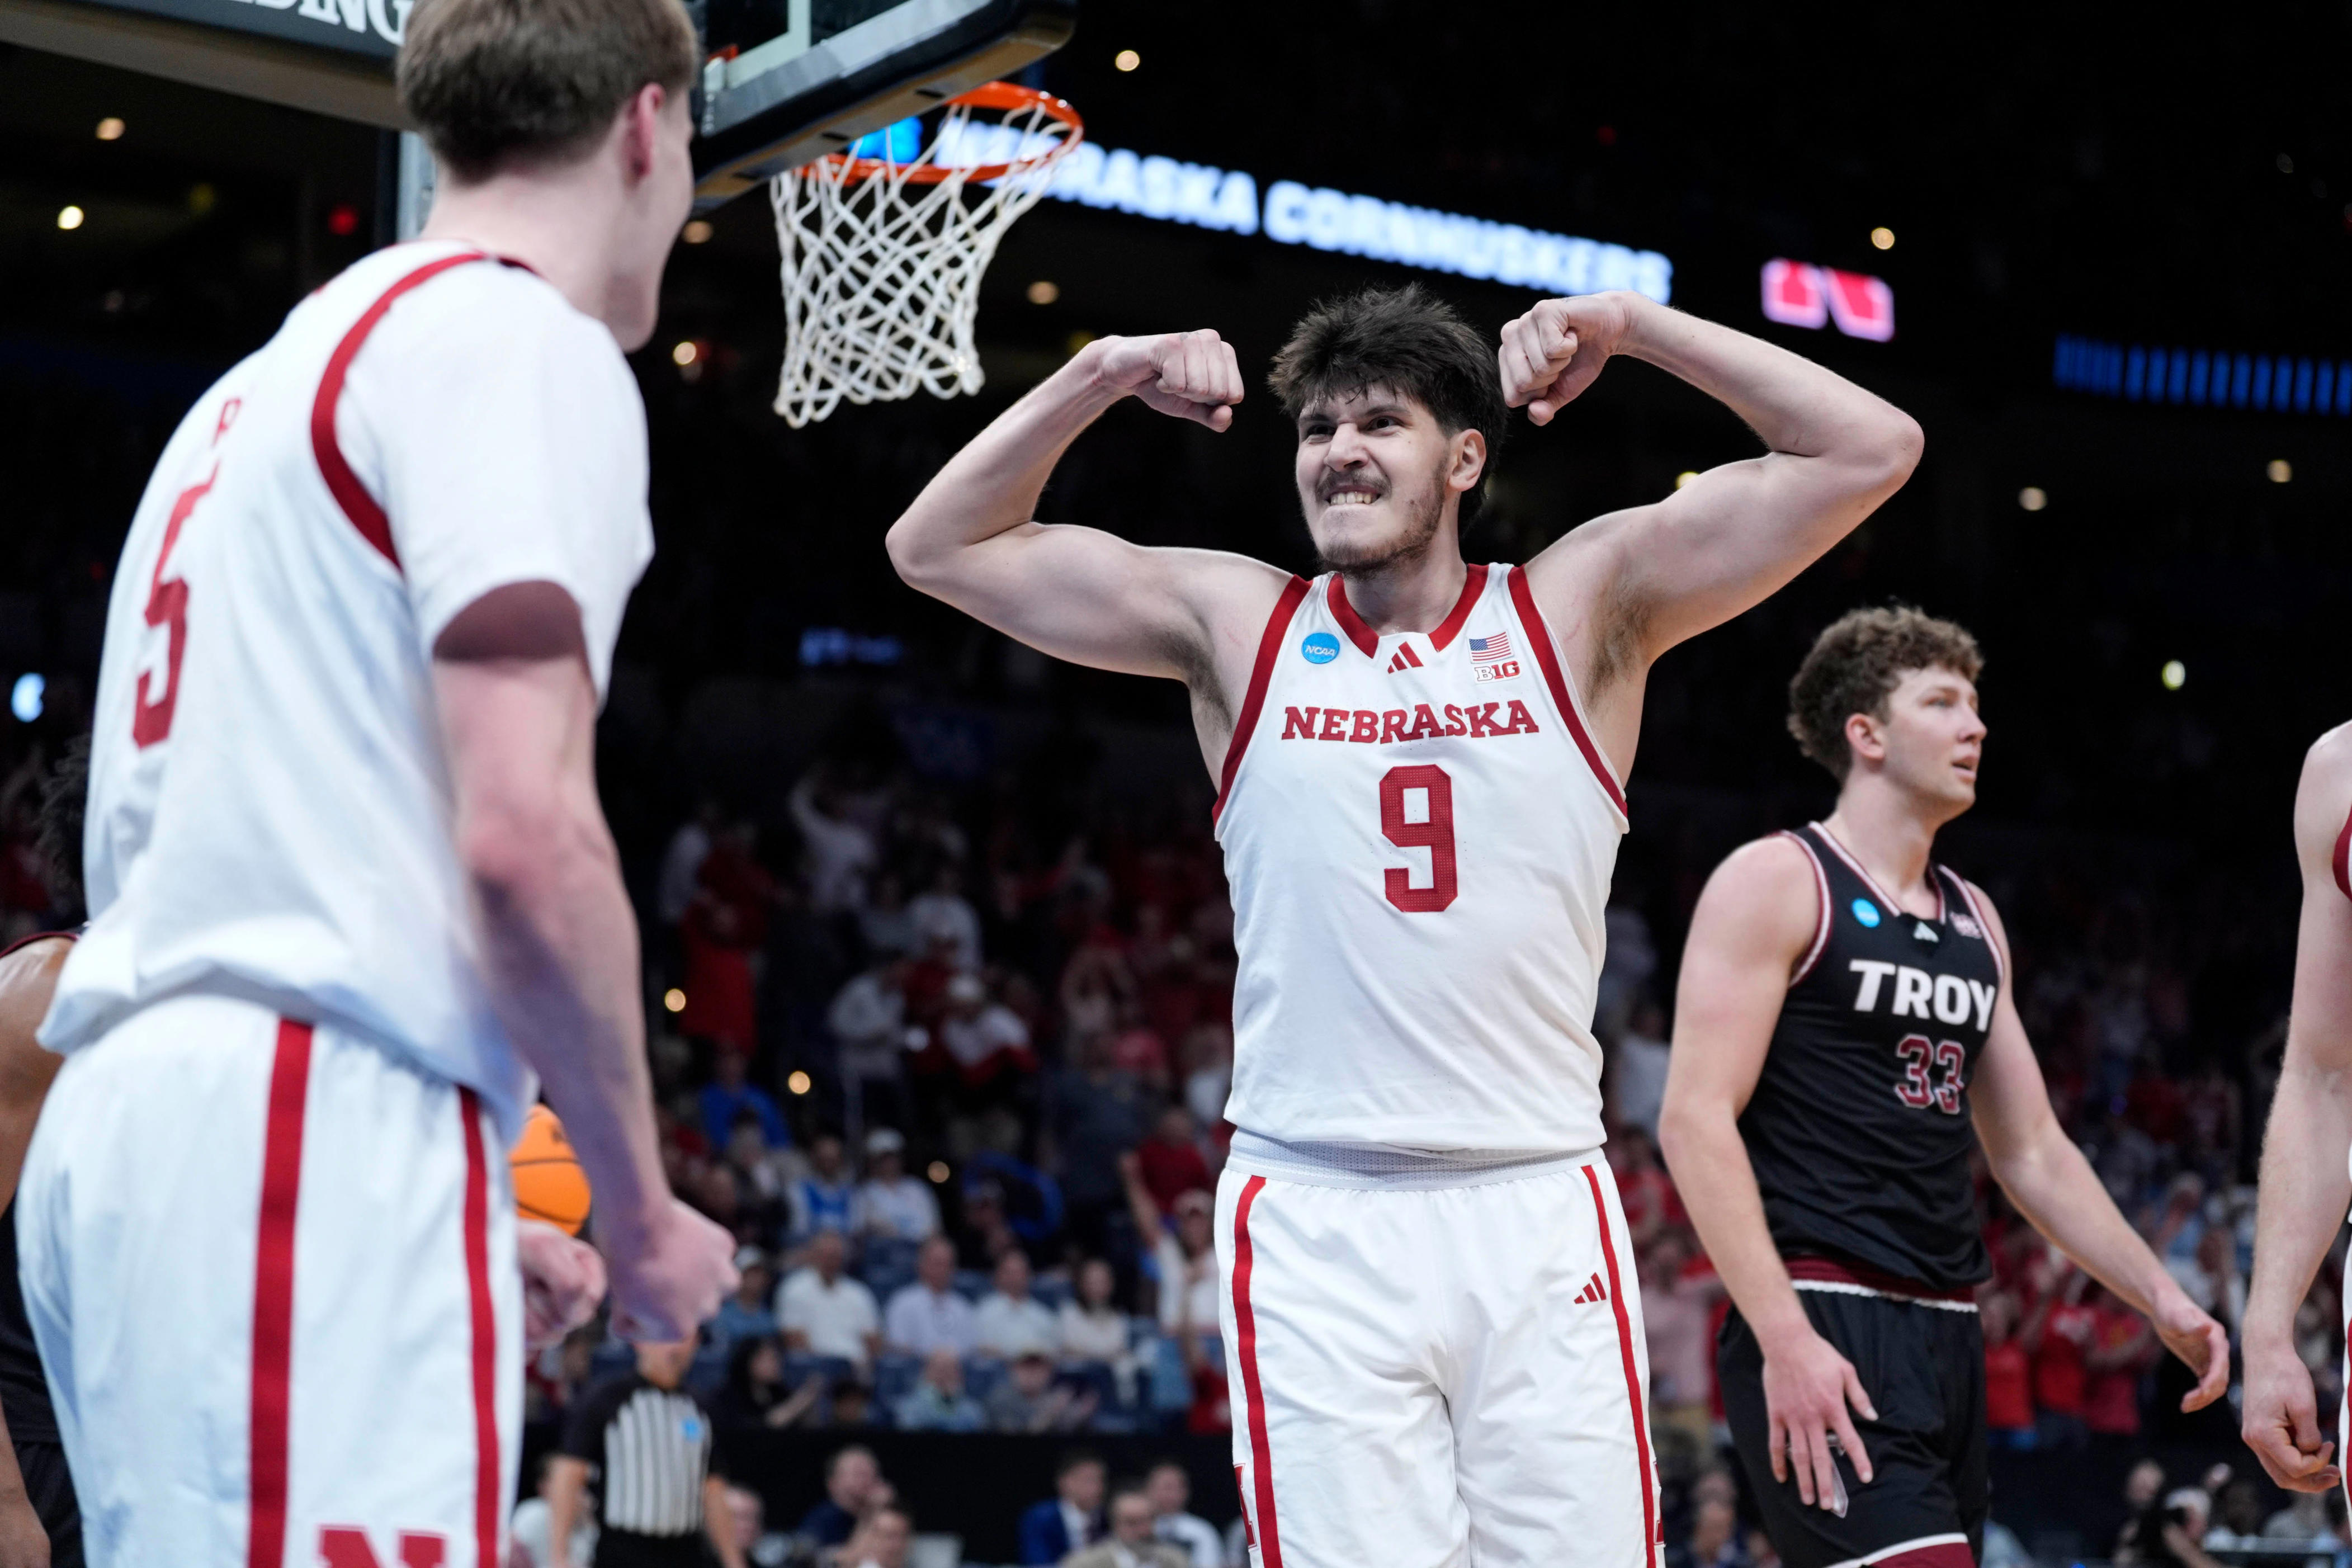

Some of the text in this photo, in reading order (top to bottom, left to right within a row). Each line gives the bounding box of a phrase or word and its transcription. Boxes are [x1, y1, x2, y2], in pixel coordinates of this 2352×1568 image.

[1305, 645, 1335, 657] NCAA
[1281, 699, 1539, 744] NEBRASKA
[1379, 764, 1458, 913] 9
[1849, 958, 1996, 1032] TROY
[1894, 1033, 1965, 1114] 33
